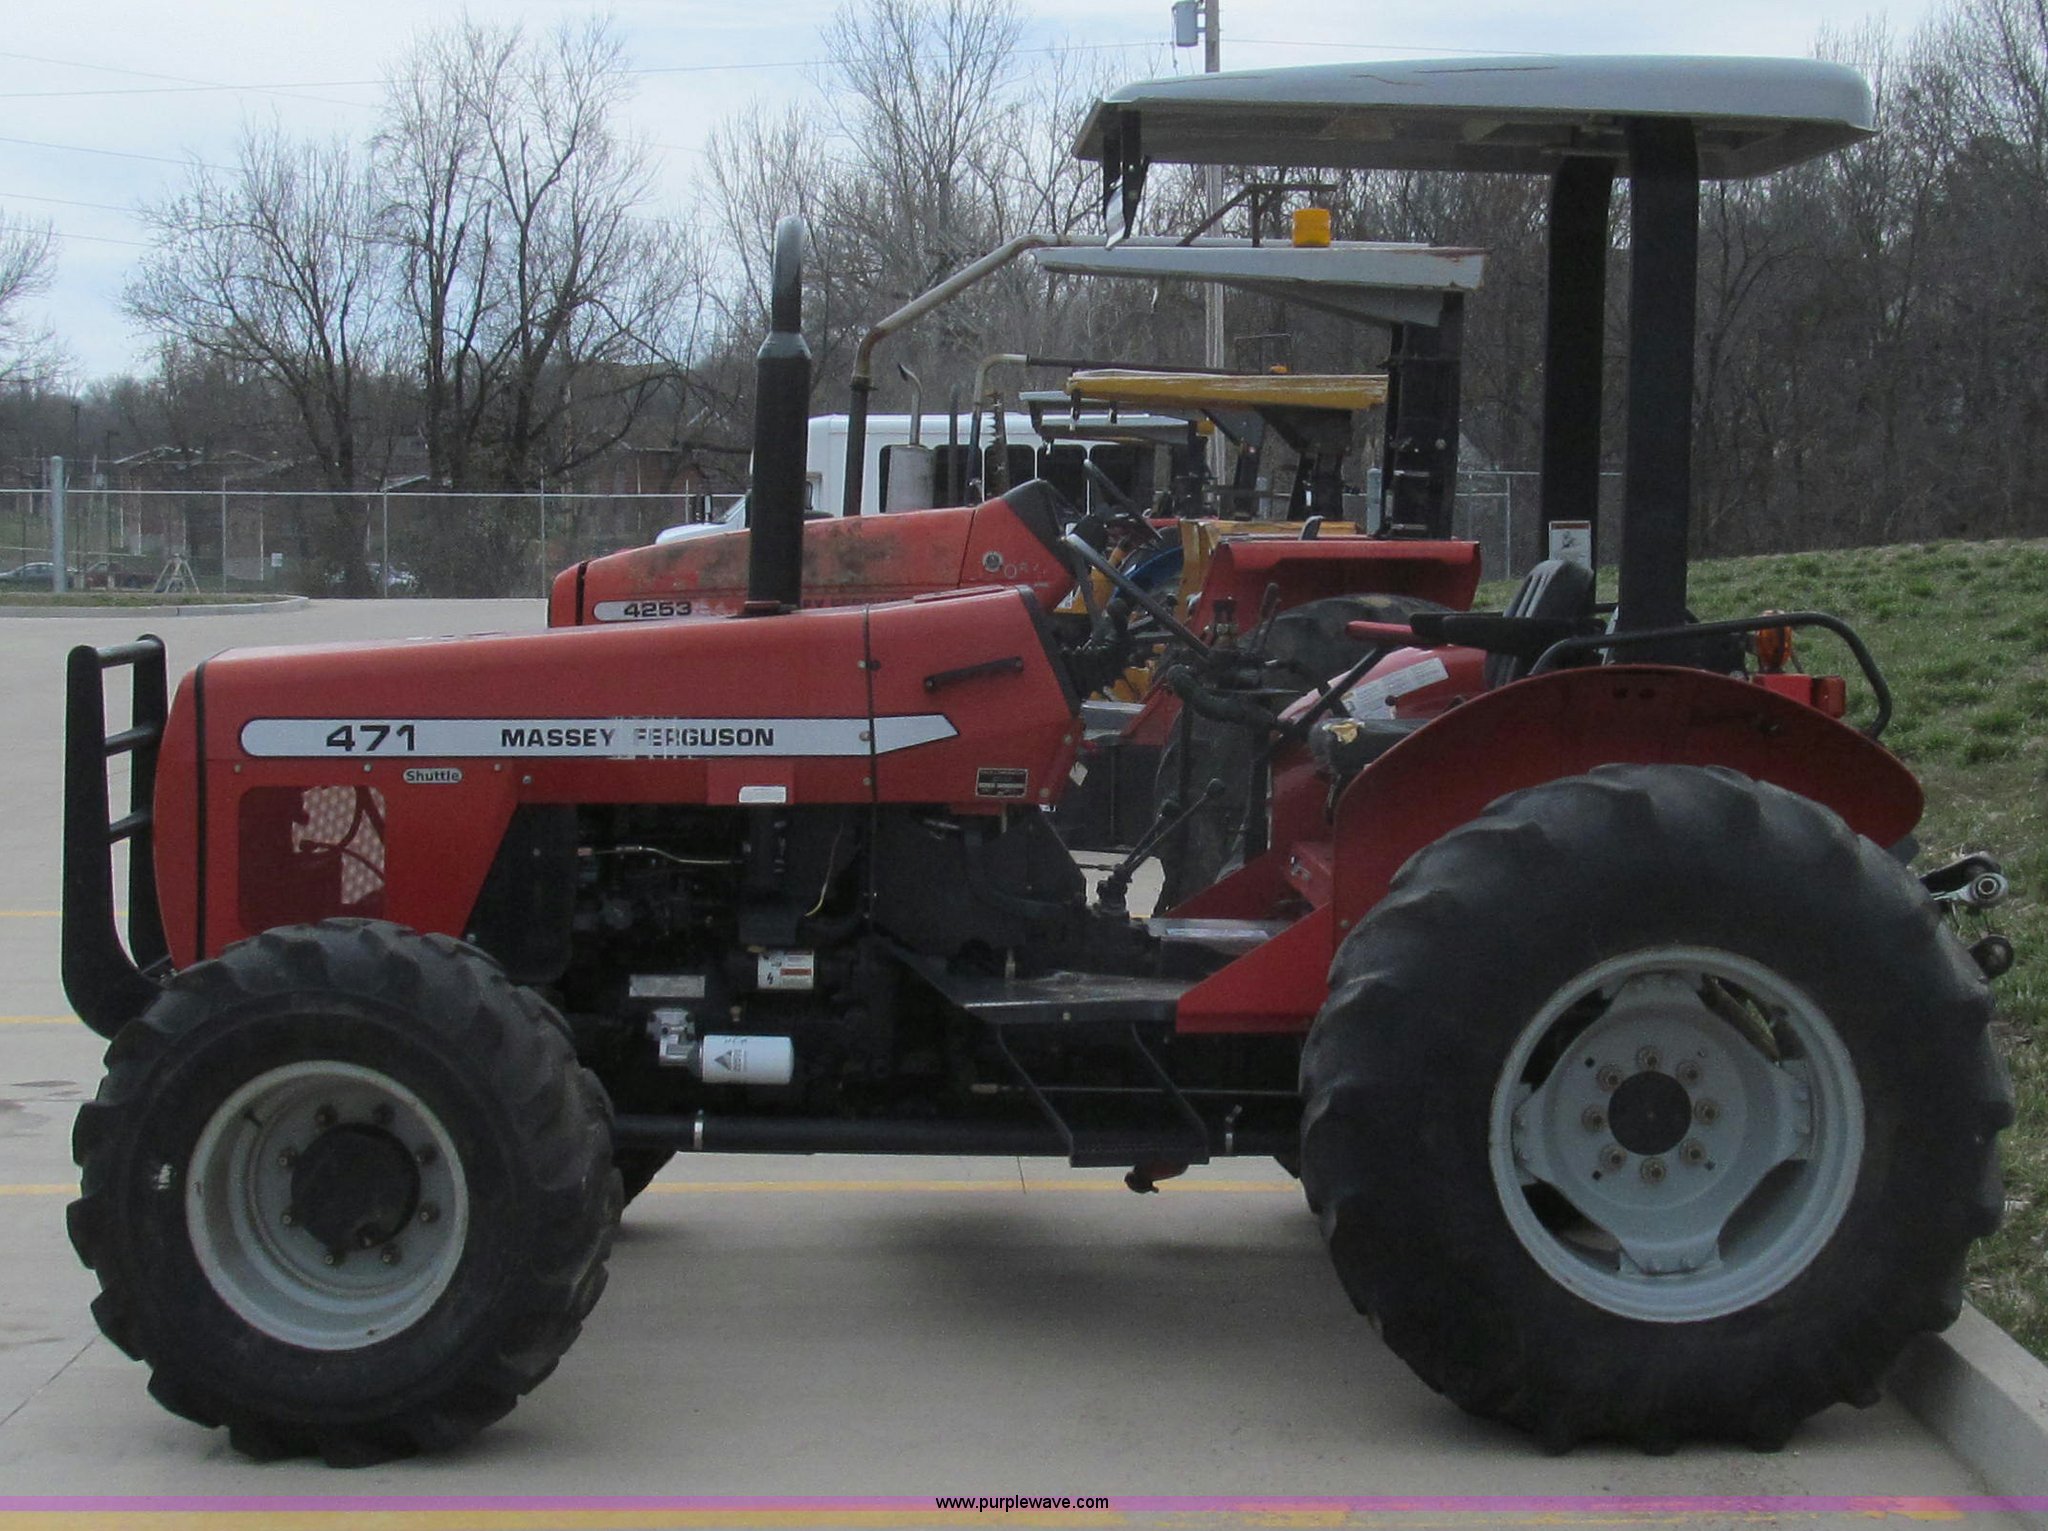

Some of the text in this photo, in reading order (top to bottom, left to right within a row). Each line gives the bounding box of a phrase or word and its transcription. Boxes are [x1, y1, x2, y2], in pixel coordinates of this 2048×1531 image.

[623, 601, 692, 618] 4253
[326, 724, 775, 752] 471 MASSEY FERGUSON
[405, 769, 460, 782] Shuttle
